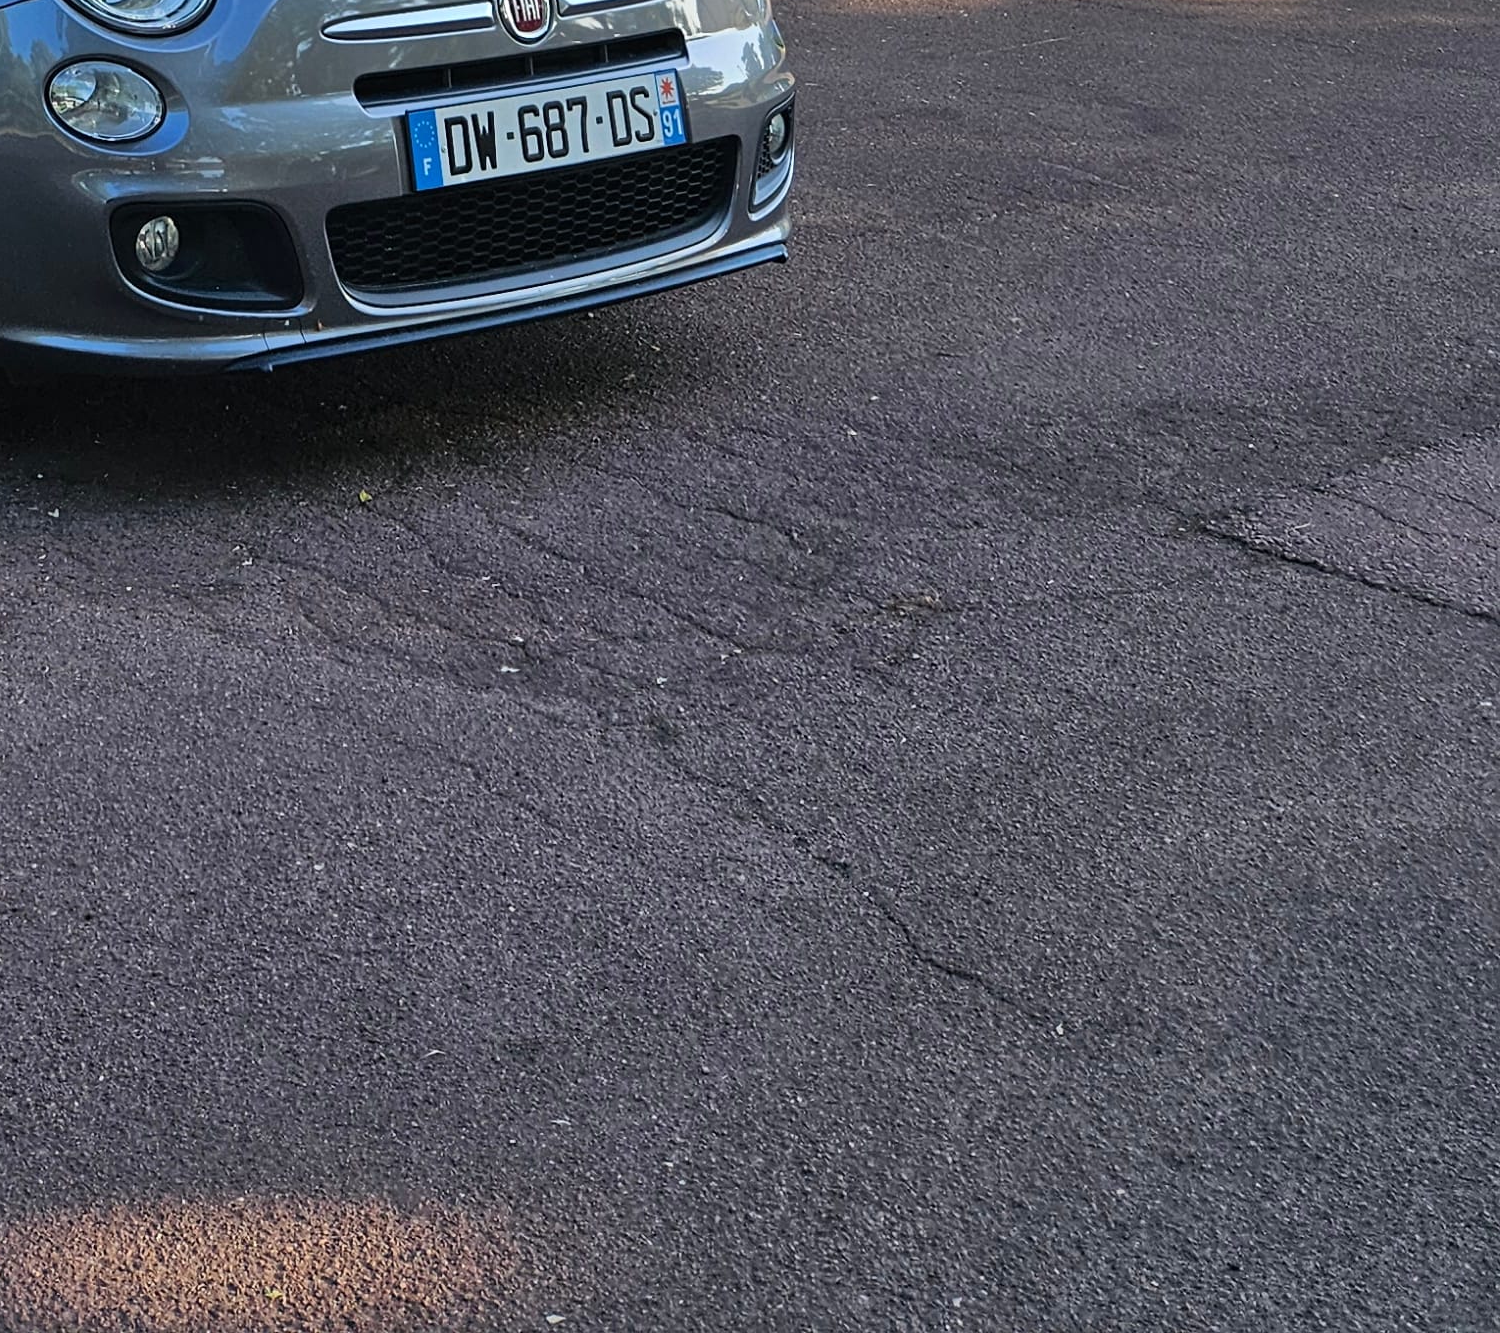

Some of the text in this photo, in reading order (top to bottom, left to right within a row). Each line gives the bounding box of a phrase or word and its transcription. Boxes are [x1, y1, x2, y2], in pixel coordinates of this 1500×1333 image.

[444, 86, 655, 176] DW-687-DS
[662, 108, 683, 137] 91
[423, 158, 433, 176] F
